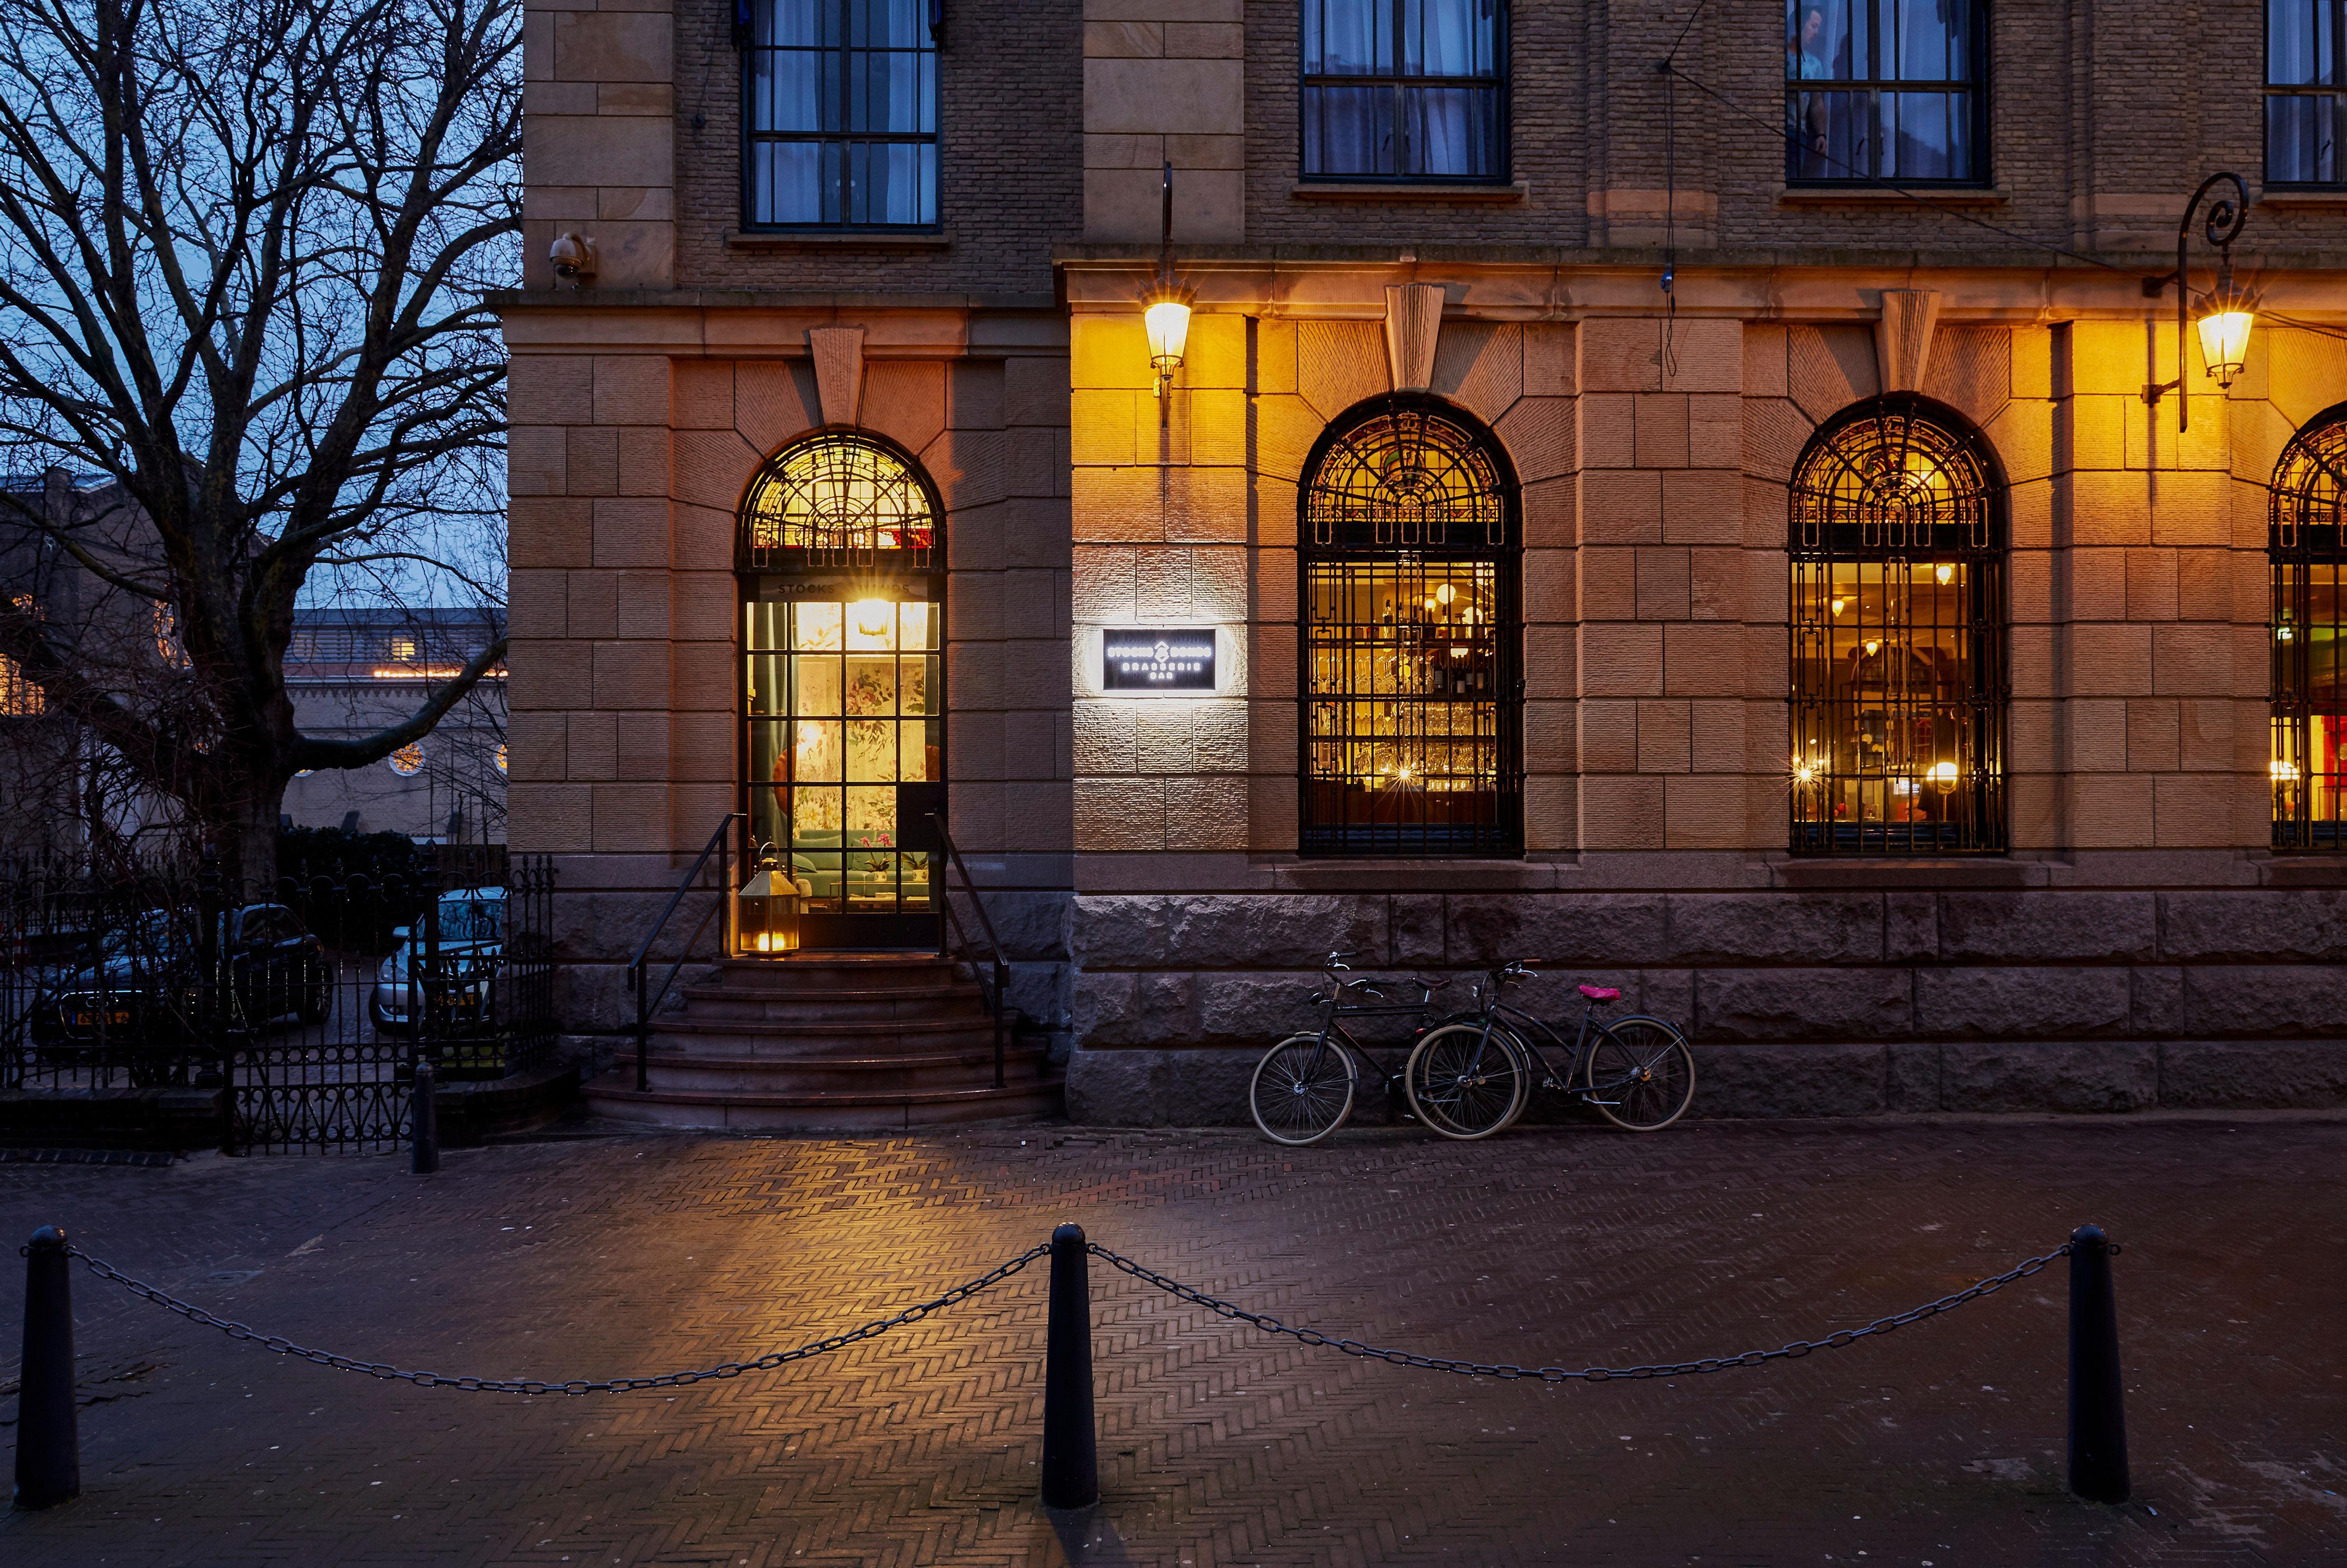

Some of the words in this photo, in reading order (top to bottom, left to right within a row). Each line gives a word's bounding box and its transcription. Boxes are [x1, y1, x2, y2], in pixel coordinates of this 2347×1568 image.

[779, 584, 835, 593] STOCKS
[1108, 647, 1153, 657] STOCKS
[1122, 663, 1200, 671] BRASSERIE
